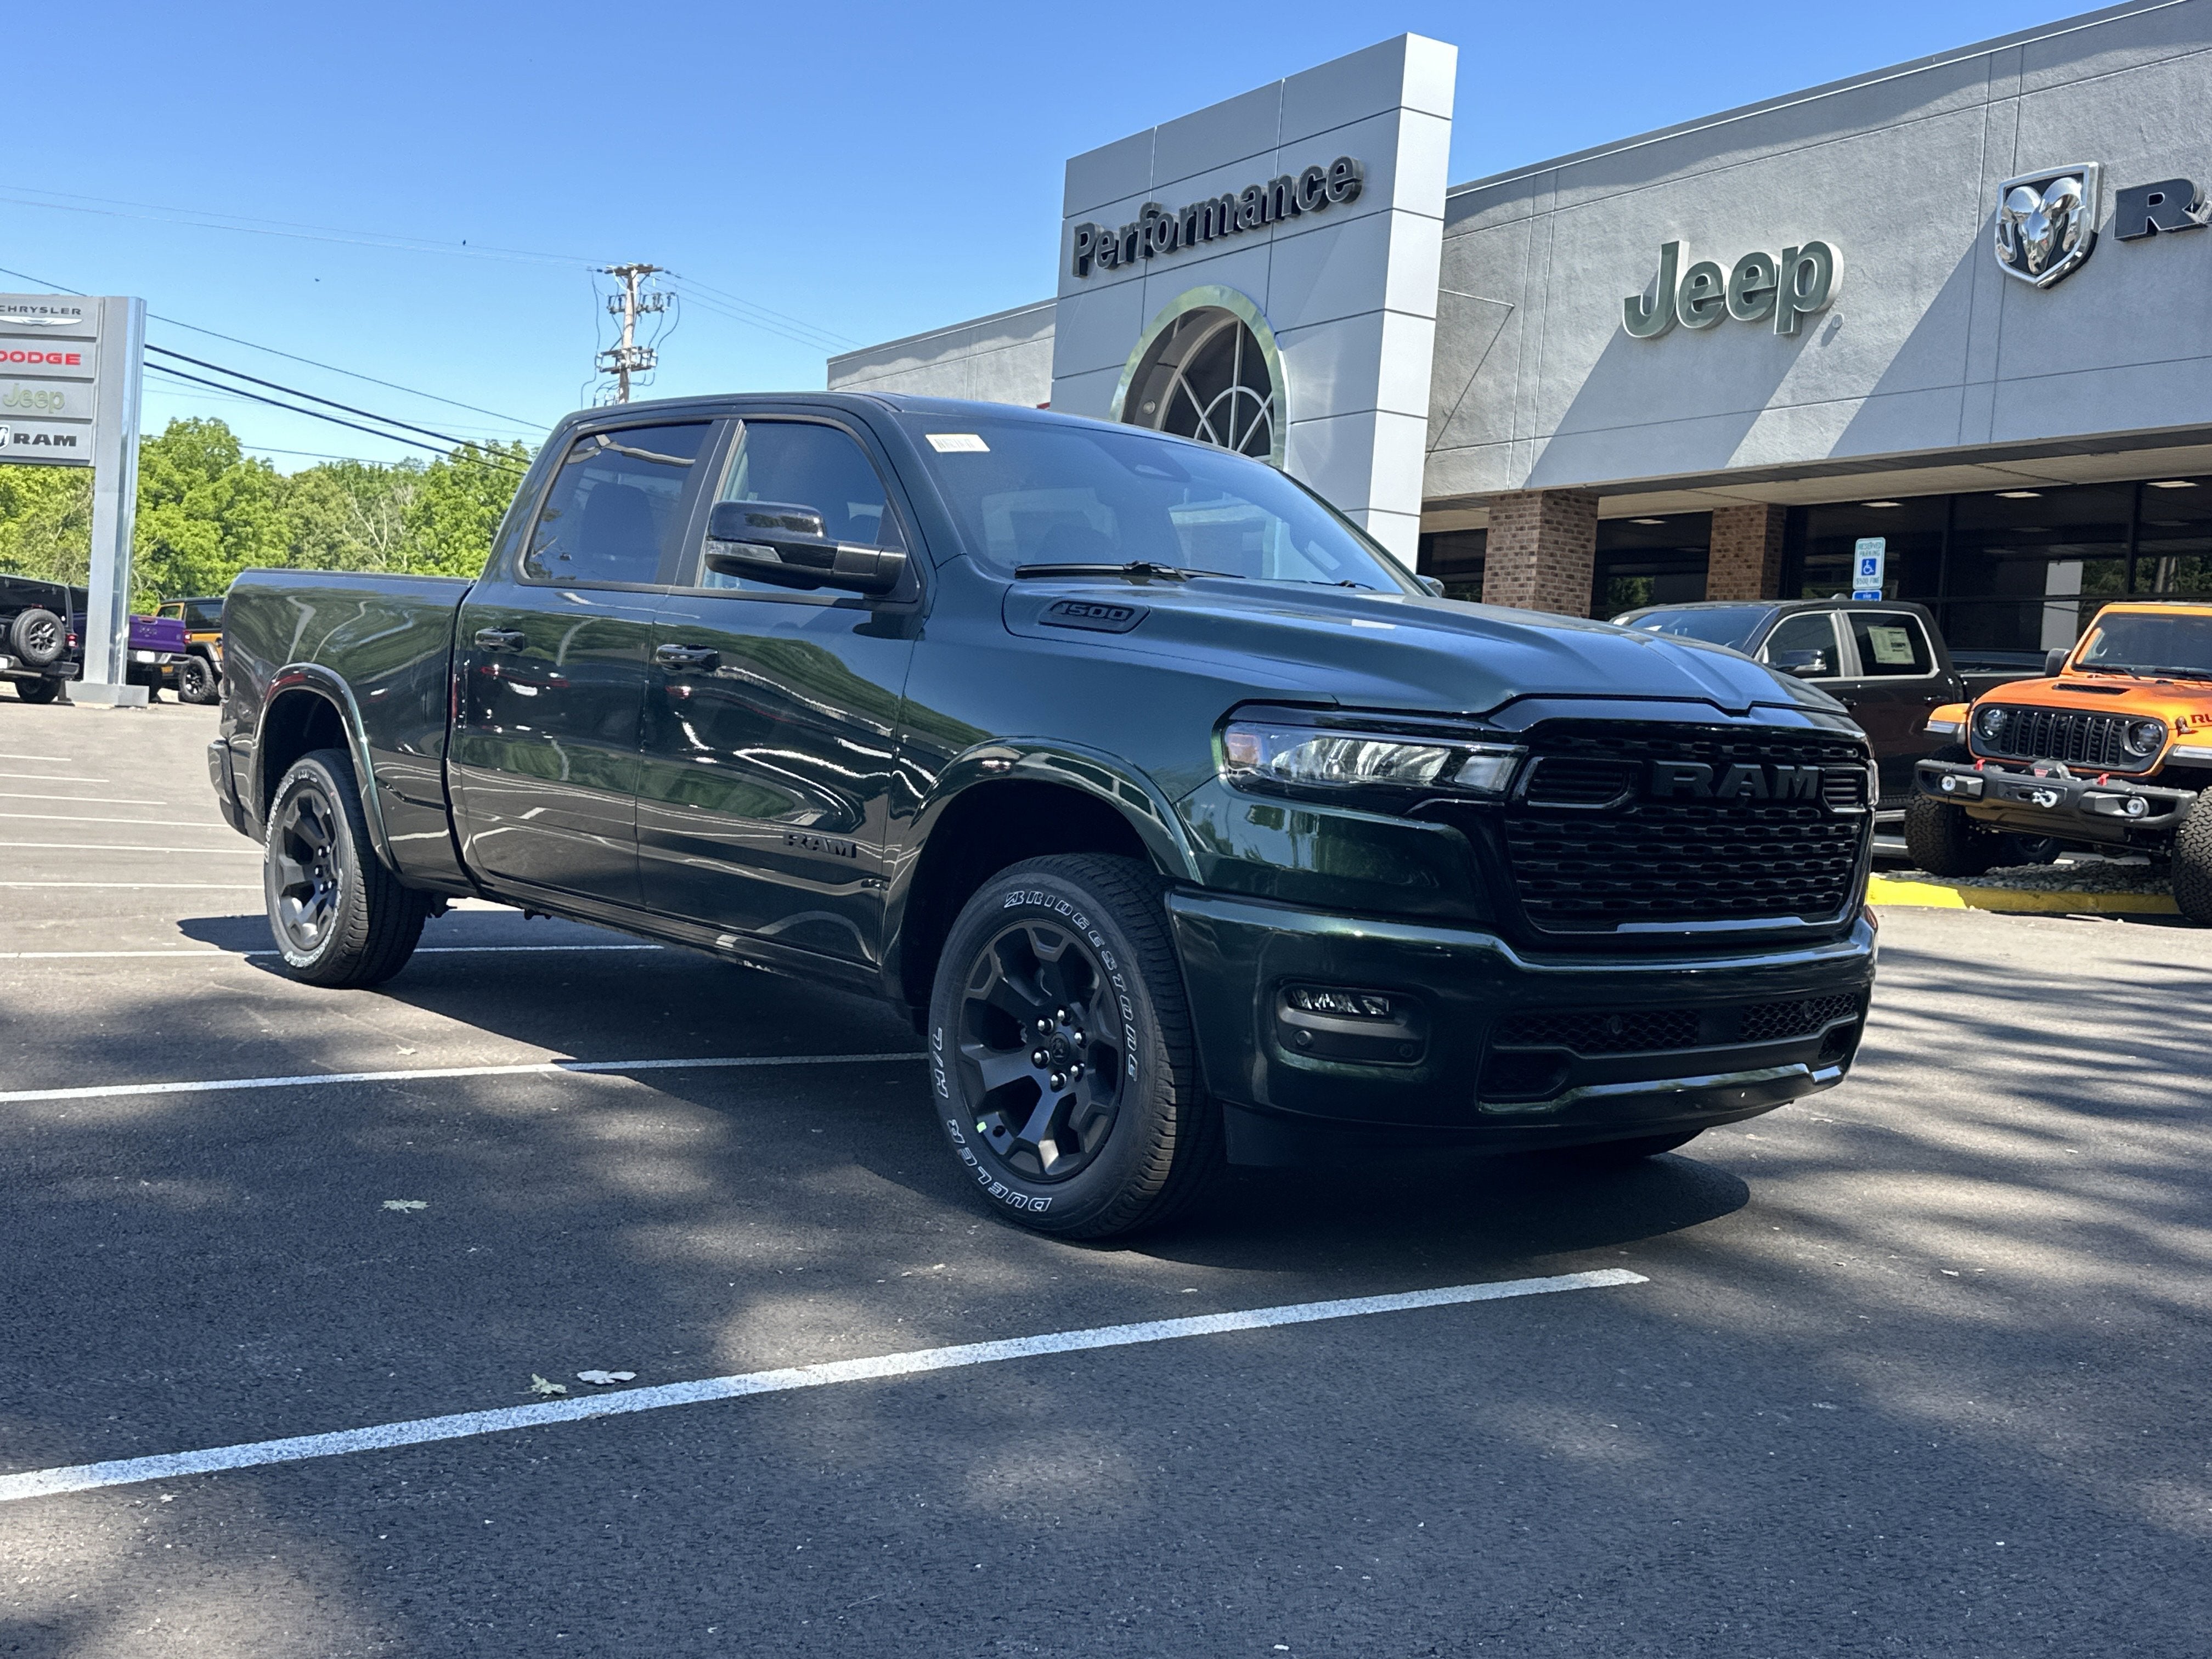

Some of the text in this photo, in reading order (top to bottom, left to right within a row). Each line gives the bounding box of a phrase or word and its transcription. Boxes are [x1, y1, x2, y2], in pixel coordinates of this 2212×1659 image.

[1073, 155, 1364, 278] Performance
[2113, 178, 2212, 240] R
[1622, 240, 1844, 338] Jeep
[2, 383, 65, 414] Jeep
[13, 433, 77, 447] RAM
[1052, 603, 1130, 621] 1500
[1651, 760, 1819, 799] RAM
[783, 832, 857, 858] RAM
[1004, 891, 1138, 1082] BRIDGESTONE
[933, 1027, 1052, 1212] DUELER H/L
